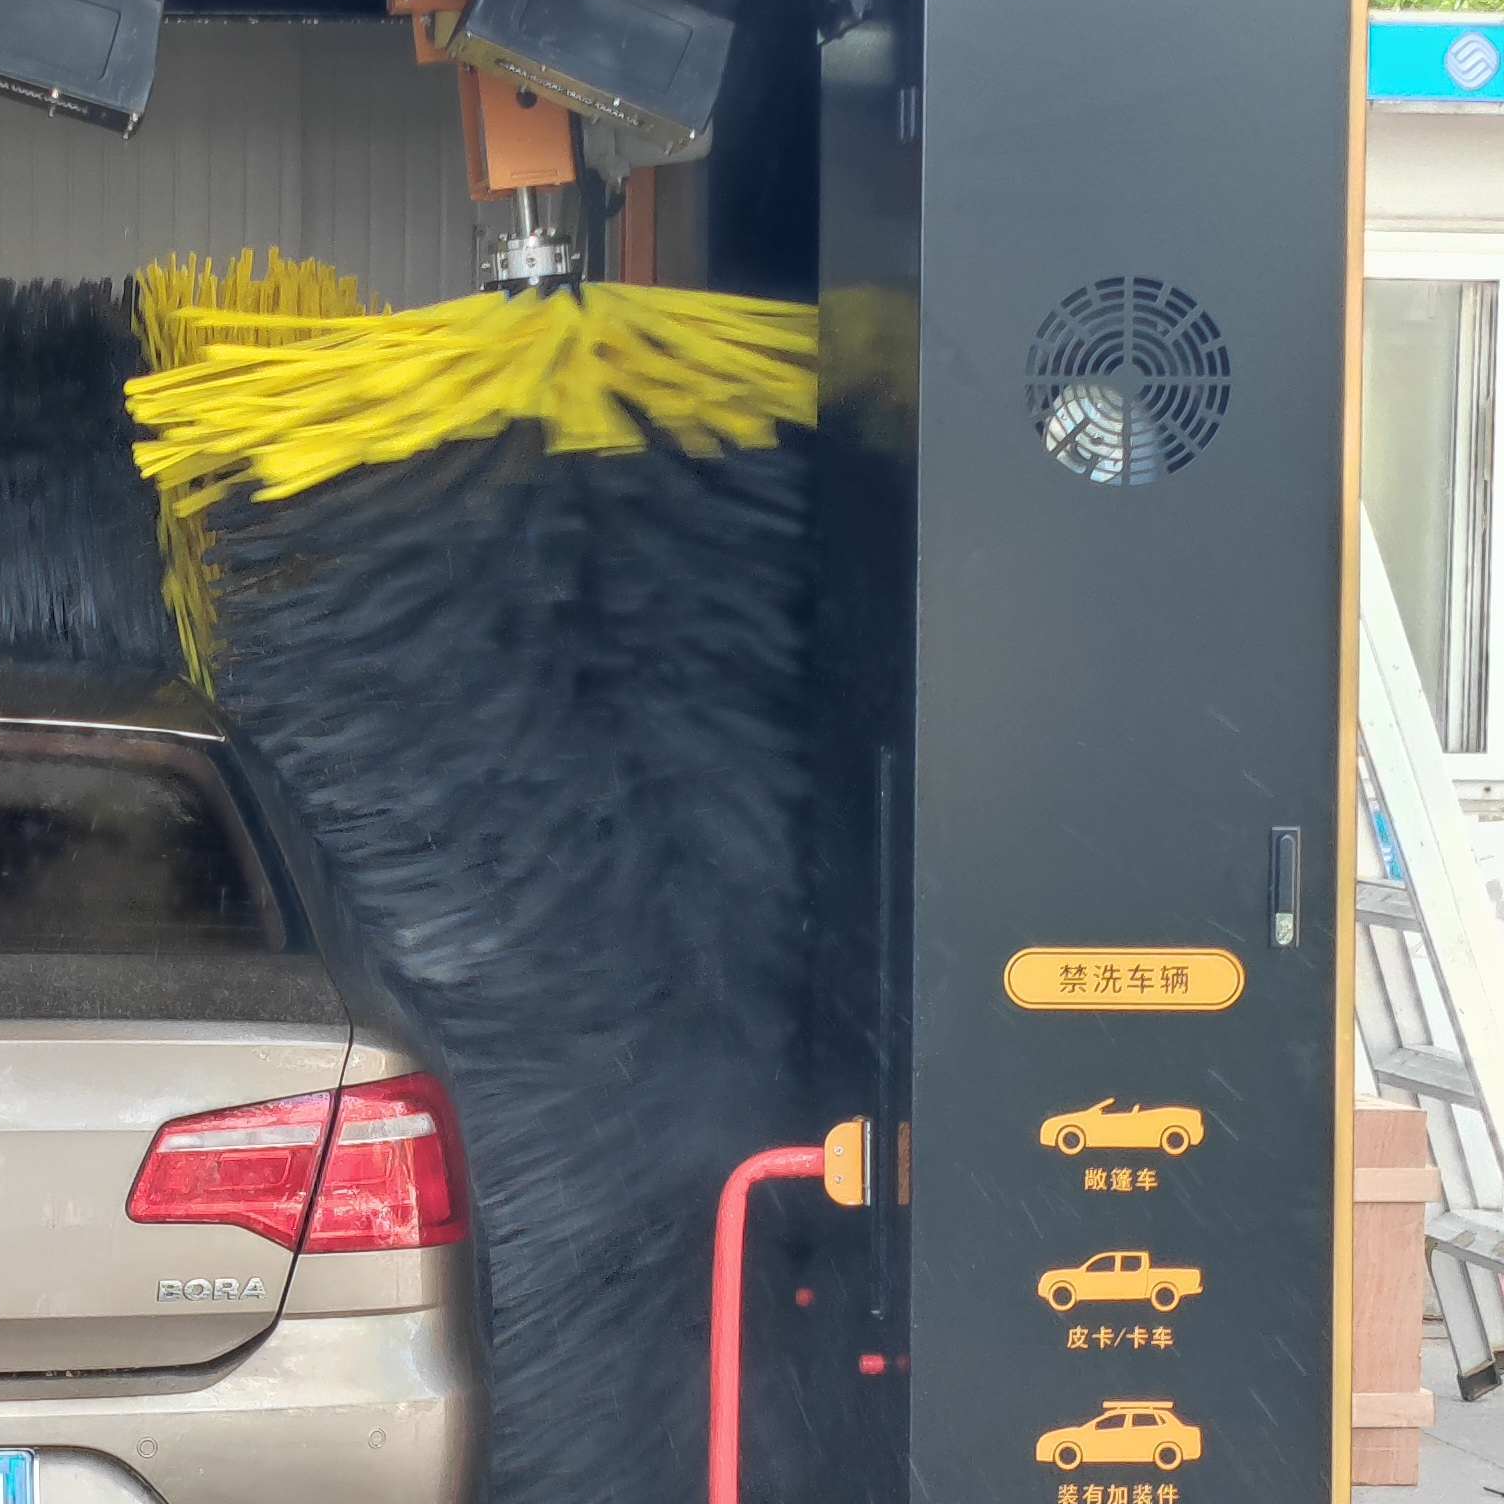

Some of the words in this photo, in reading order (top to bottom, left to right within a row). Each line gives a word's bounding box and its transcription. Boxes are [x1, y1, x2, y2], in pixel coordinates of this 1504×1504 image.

[1058, 963, 1190, 995] 禁洗车辆
[1083, 1167, 1159, 1193] 敞篷车
[156, 1276, 267, 1302] BORA
[1066, 1324, 1175, 1351] 皮卡/卡车
